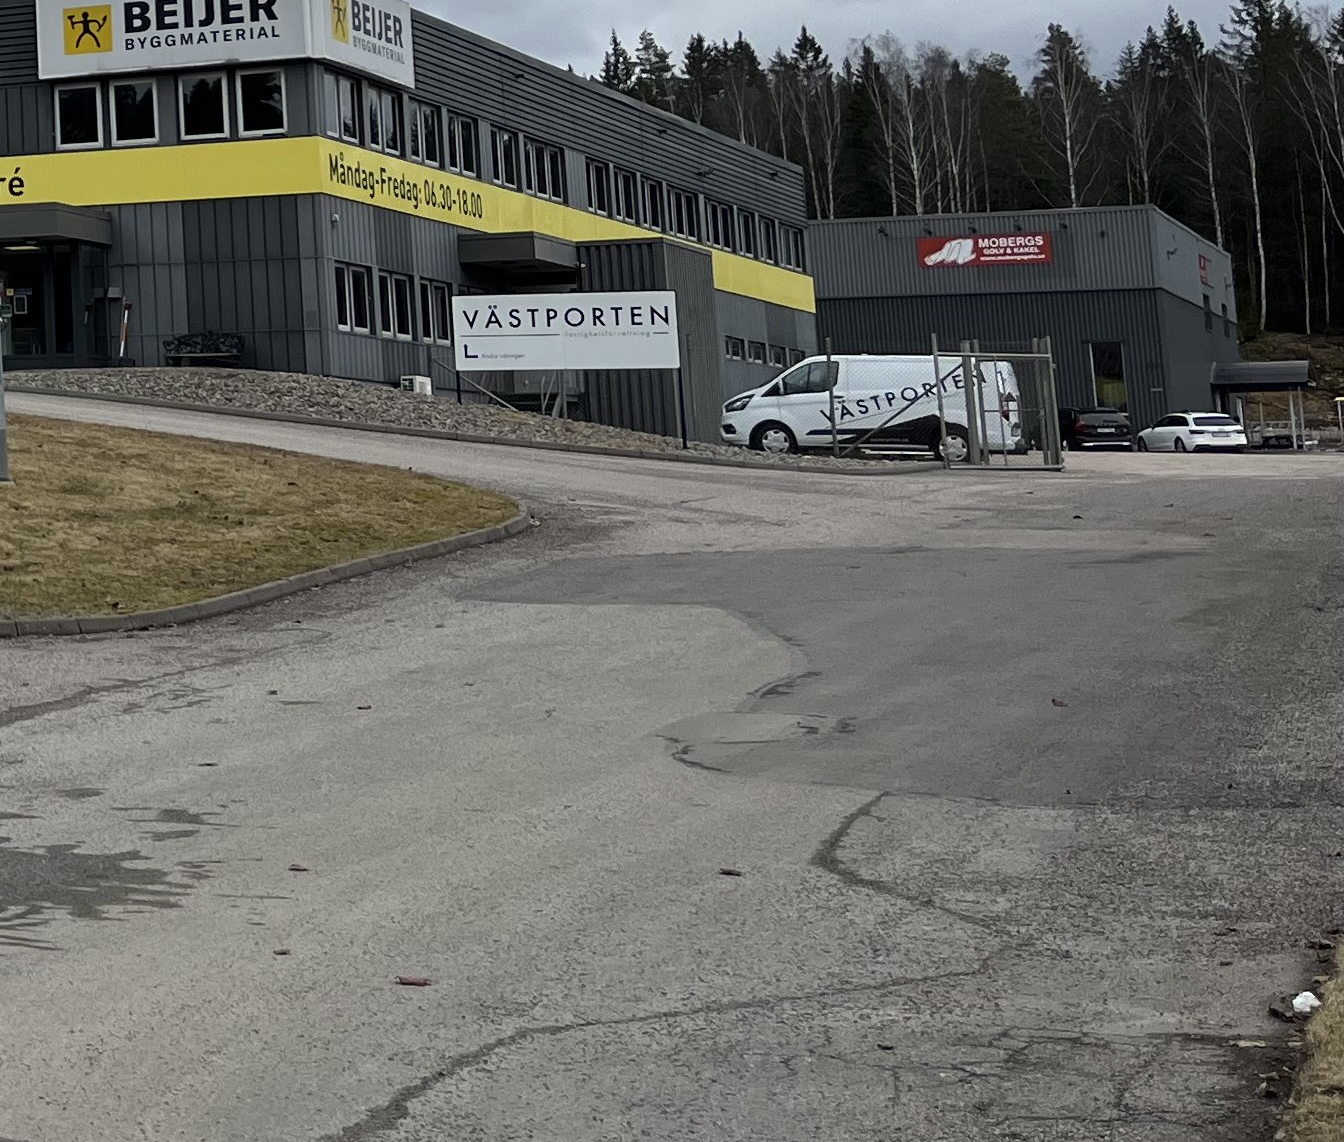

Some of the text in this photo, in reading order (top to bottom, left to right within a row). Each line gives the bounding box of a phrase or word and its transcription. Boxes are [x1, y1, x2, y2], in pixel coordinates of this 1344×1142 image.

[351, 0, 403, 48] BEIJER
[124, 25, 281, 51] BYGGMATERIAL
[353, 35, 405, 65] BYGGMATERIAL
[328, 151, 483, 219] Måndag-Fredag: 06.30-18.00
[978, 236, 1044, 248] MOBERGS
[983, 247, 1005, 255] GOLV
[1013, 246, 1040, 254] KAKEL
[462, 304, 670, 330] VÄSTPORTEN
